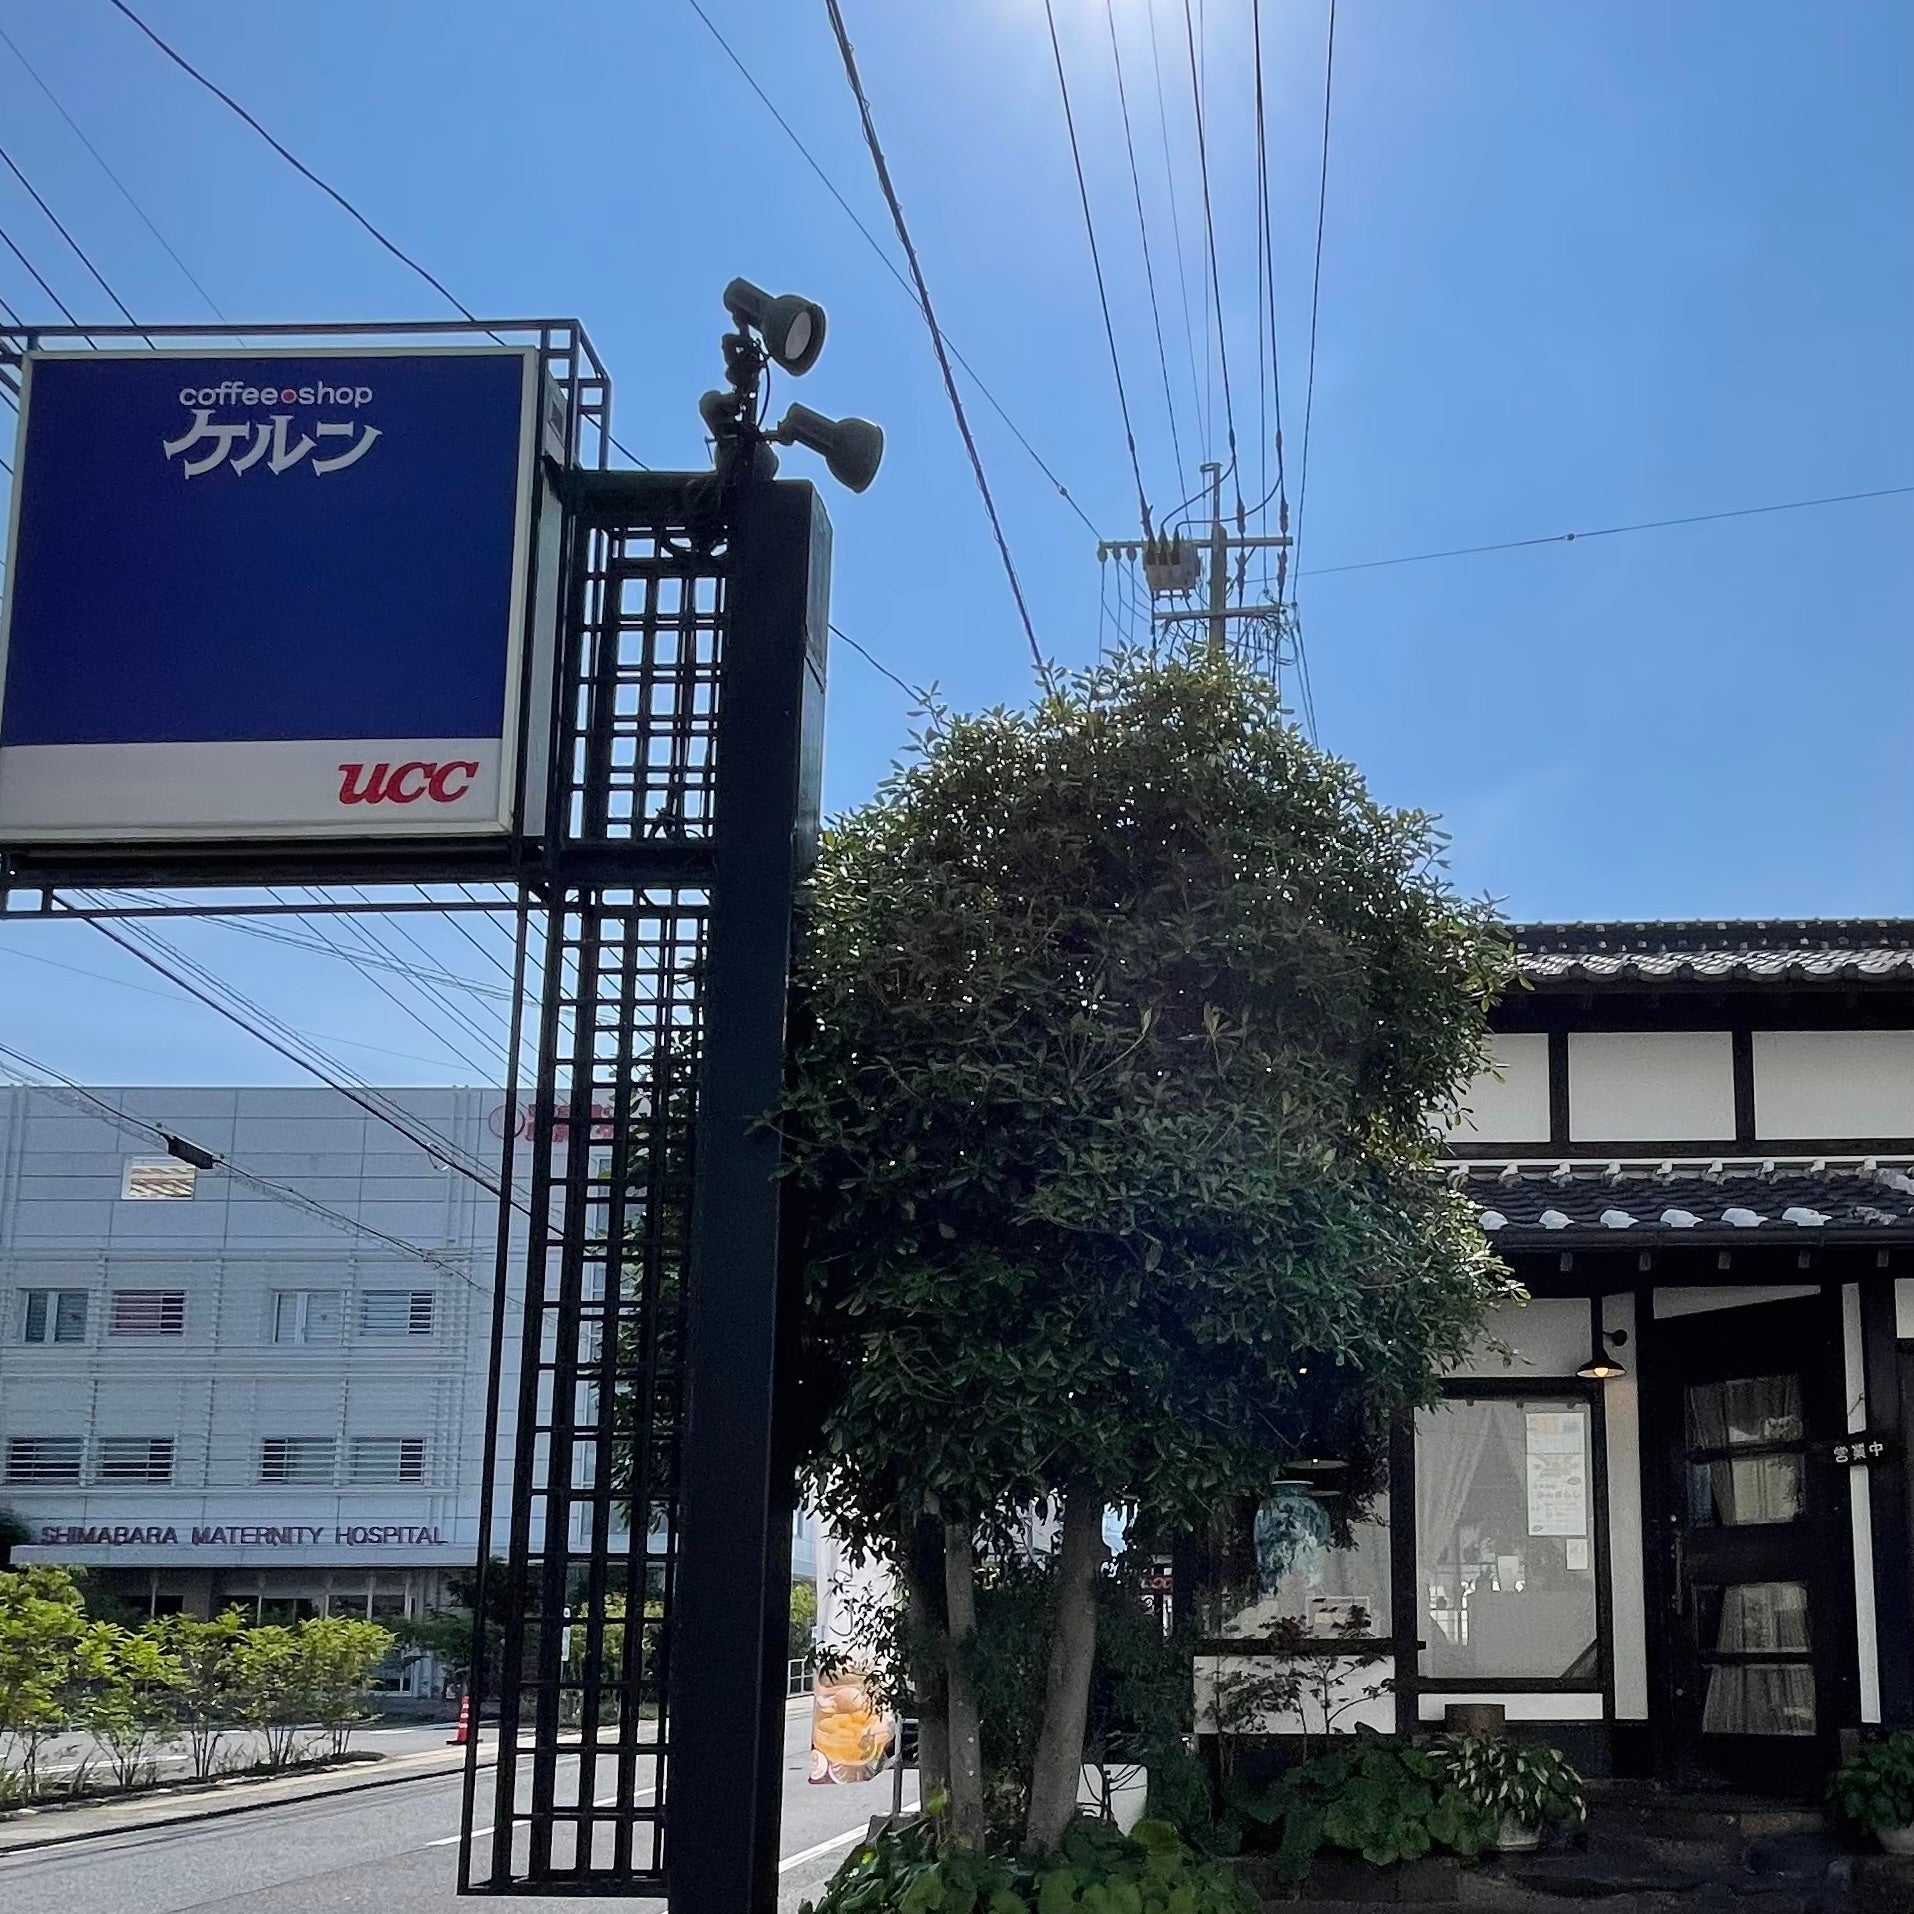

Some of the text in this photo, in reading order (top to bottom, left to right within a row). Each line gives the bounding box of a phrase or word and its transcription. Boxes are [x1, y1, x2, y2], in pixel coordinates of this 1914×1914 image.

[179, 380, 373, 408] coffee shop
[163, 408, 383, 480] ケルン
[1833, 1440, 1884, 1463] 営業中
[41, 1526, 448, 1546] SHIMABARA MATERNITY HOSPITAL
